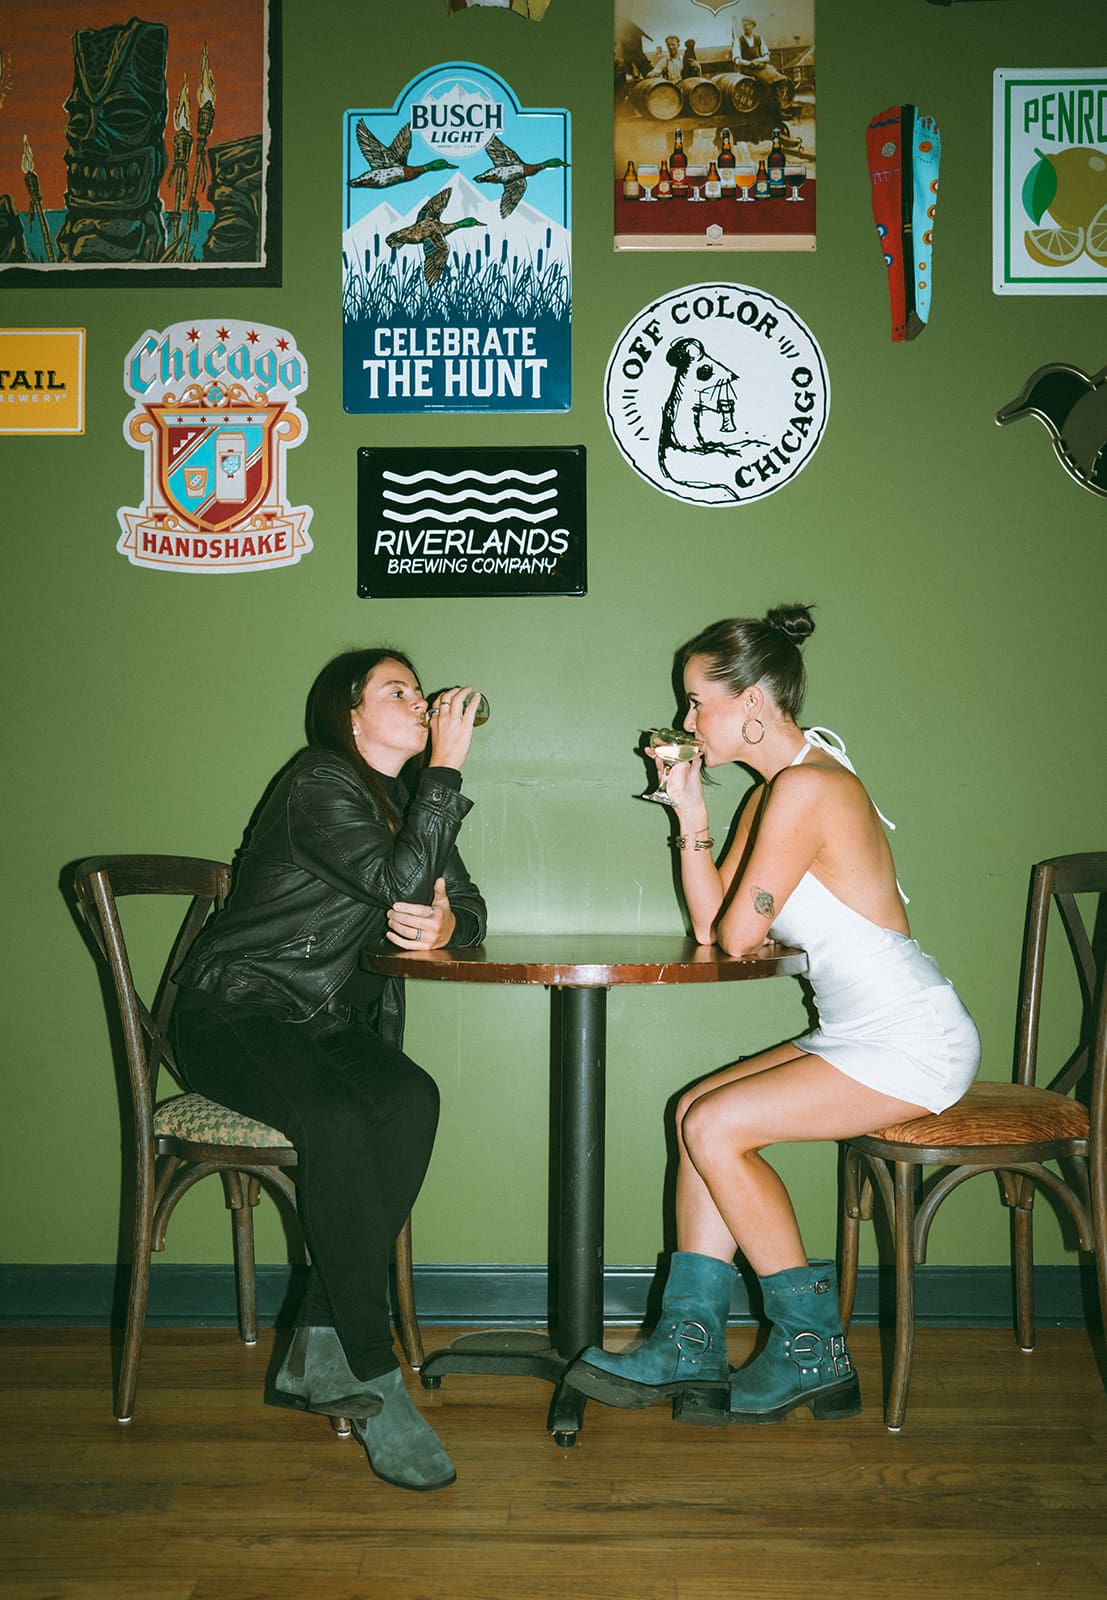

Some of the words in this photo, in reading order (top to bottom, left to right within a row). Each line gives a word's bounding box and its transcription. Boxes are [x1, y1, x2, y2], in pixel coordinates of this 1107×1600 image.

[411, 104, 503, 130] BUSCH
[430, 131, 484, 143] LIGHT
[373, 327, 537, 357] CELEBRATE
[622, 318, 664, 380] OFF
[670, 295, 779, 339] COLOR
[131, 335, 302, 394] Chicago
[362, 358, 433, 399] THE
[445, 358, 548, 399] HUNT
[734, 367, 817, 488] CHICAGO
[143, 531, 287, 559] HANDSHAKE
[374, 529, 570, 556] RIVERLANDS
[387, 558, 468, 574] BREWING
[471, 558, 558, 575] COMPANY
